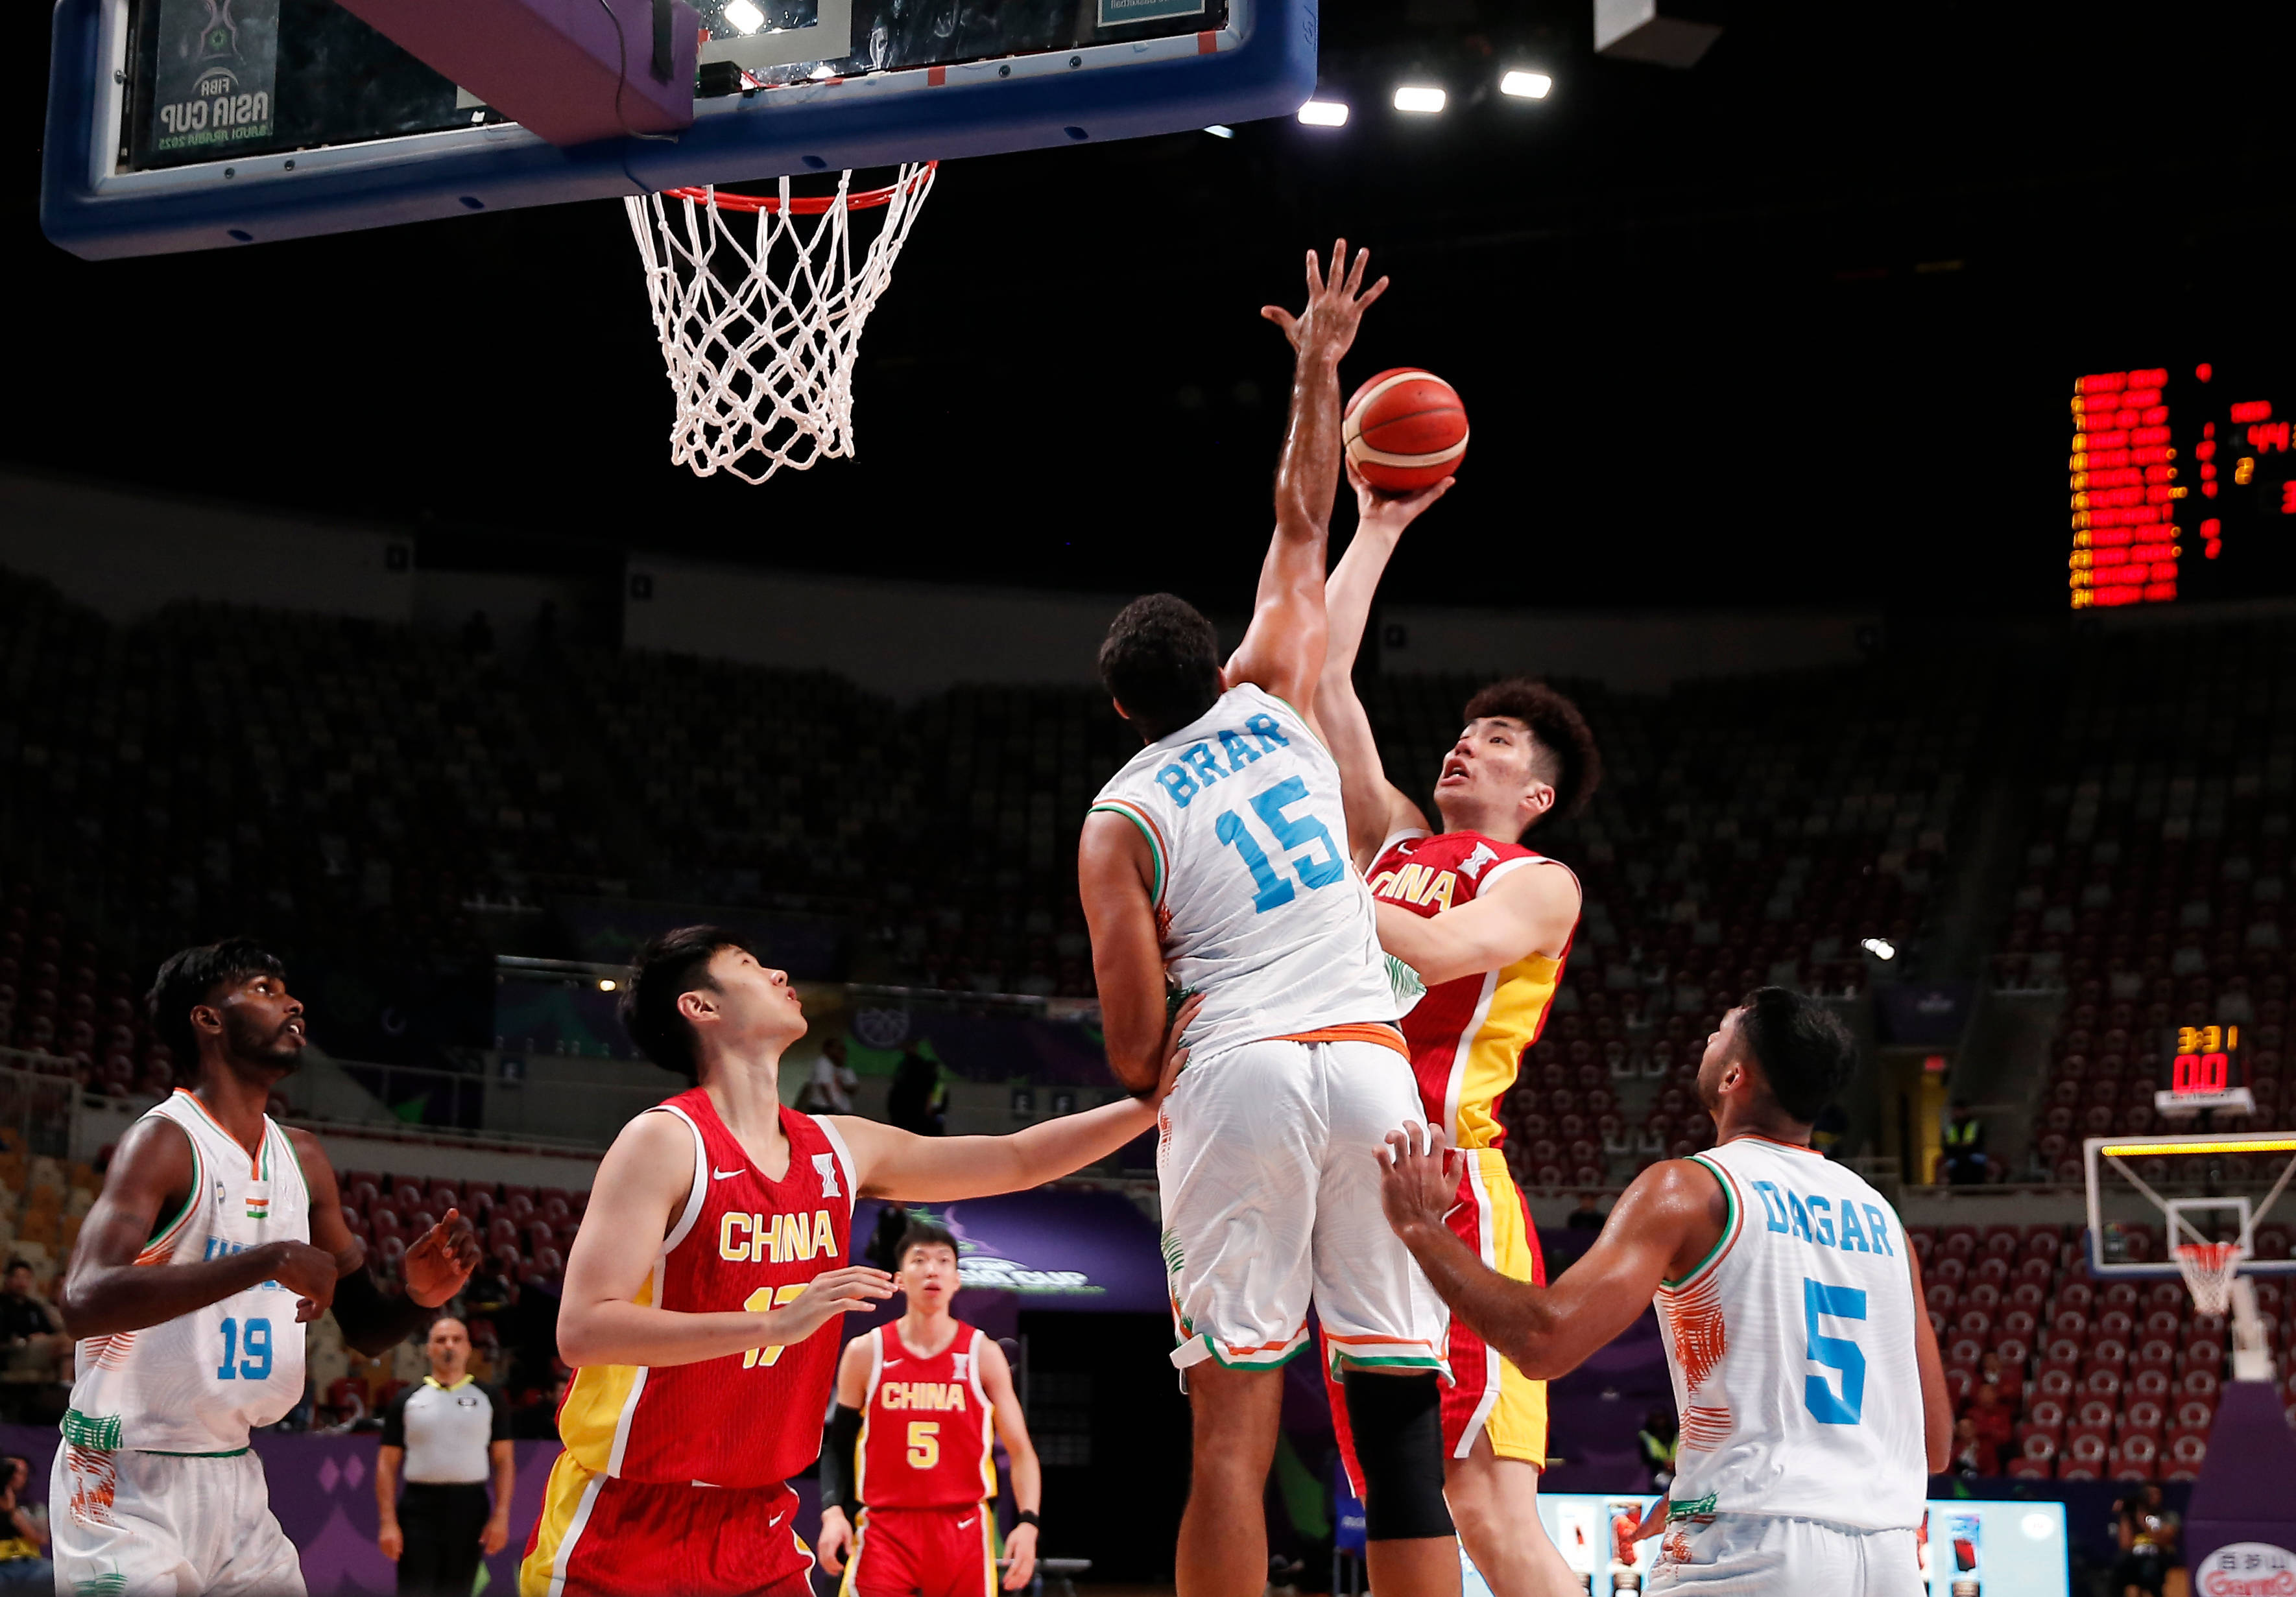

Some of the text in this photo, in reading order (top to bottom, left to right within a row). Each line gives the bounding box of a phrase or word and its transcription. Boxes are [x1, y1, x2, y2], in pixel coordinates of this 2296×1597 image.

[1154, 713, 1289, 809] BRAR
[1215, 775, 1345, 914] 15
[2177, 1025, 2238, 1054] 3:31
[2173, 1053, 2228, 1094] 00
[1752, 1180, 1893, 1257] DAGAR
[217, 1317, 272, 1380] 19
[1803, 1277, 1867, 1425] 5
[881, 1382, 966, 1412] CHINA
[907, 1421, 940, 1469] 5
